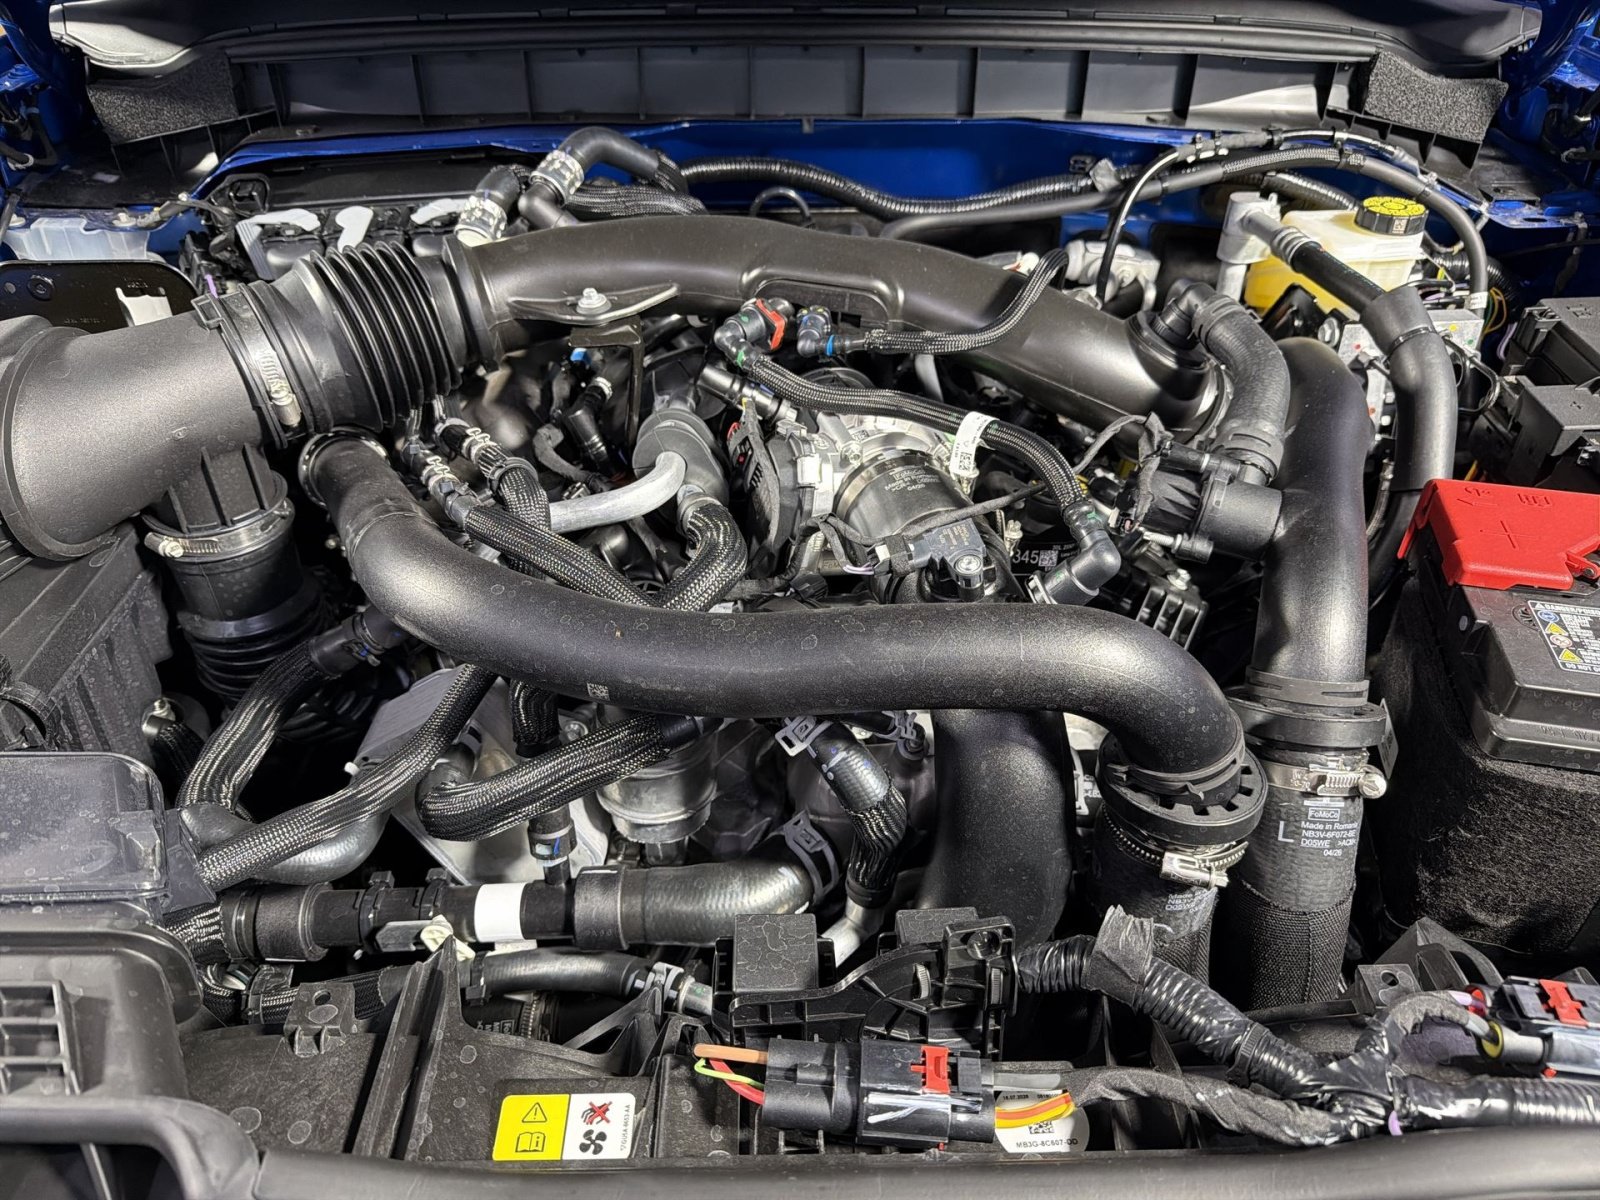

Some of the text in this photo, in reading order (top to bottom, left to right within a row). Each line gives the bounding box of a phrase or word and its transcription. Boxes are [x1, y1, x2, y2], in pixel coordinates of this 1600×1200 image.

[1309, 809, 1339, 819] FoMoCo
[1301, 821, 1324, 830] Made
[1278, 820, 1294, 843] L
